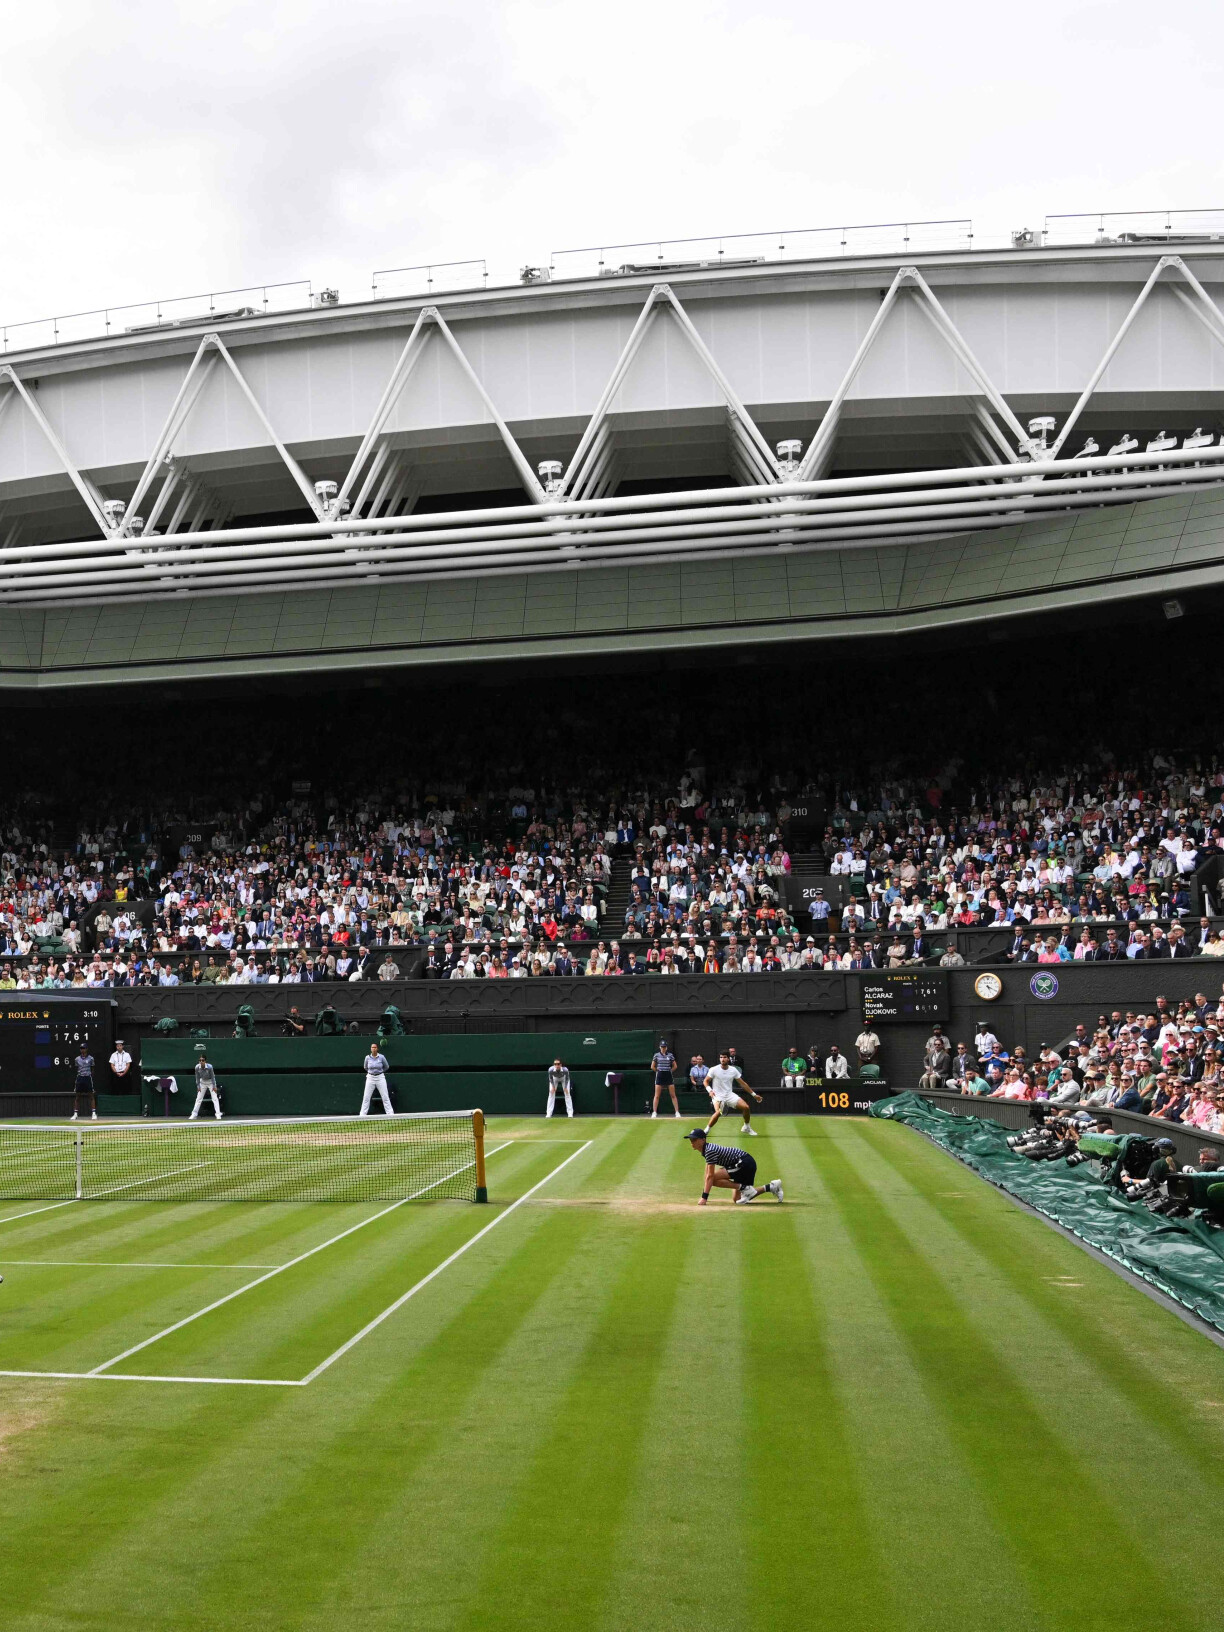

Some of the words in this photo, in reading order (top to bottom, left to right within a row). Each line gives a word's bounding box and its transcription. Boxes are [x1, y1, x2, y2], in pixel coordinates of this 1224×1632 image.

[791, 807, 808, 817] 310
[8, 1011, 38, 1019] ROLEX
[83, 1010, 98, 1018] 3:10
[54, 1033, 59, 1041] 1
[64, 1032, 70, 1041] 7
[73, 1032, 80, 1041] 6
[83, 1032, 89, 1041] 1
[54, 1057, 60, 1065] 6
[64, 1057, 70, 1065] 6
[806, 1078, 823, 1086] IBM
[818, 1092, 850, 1108] 108
